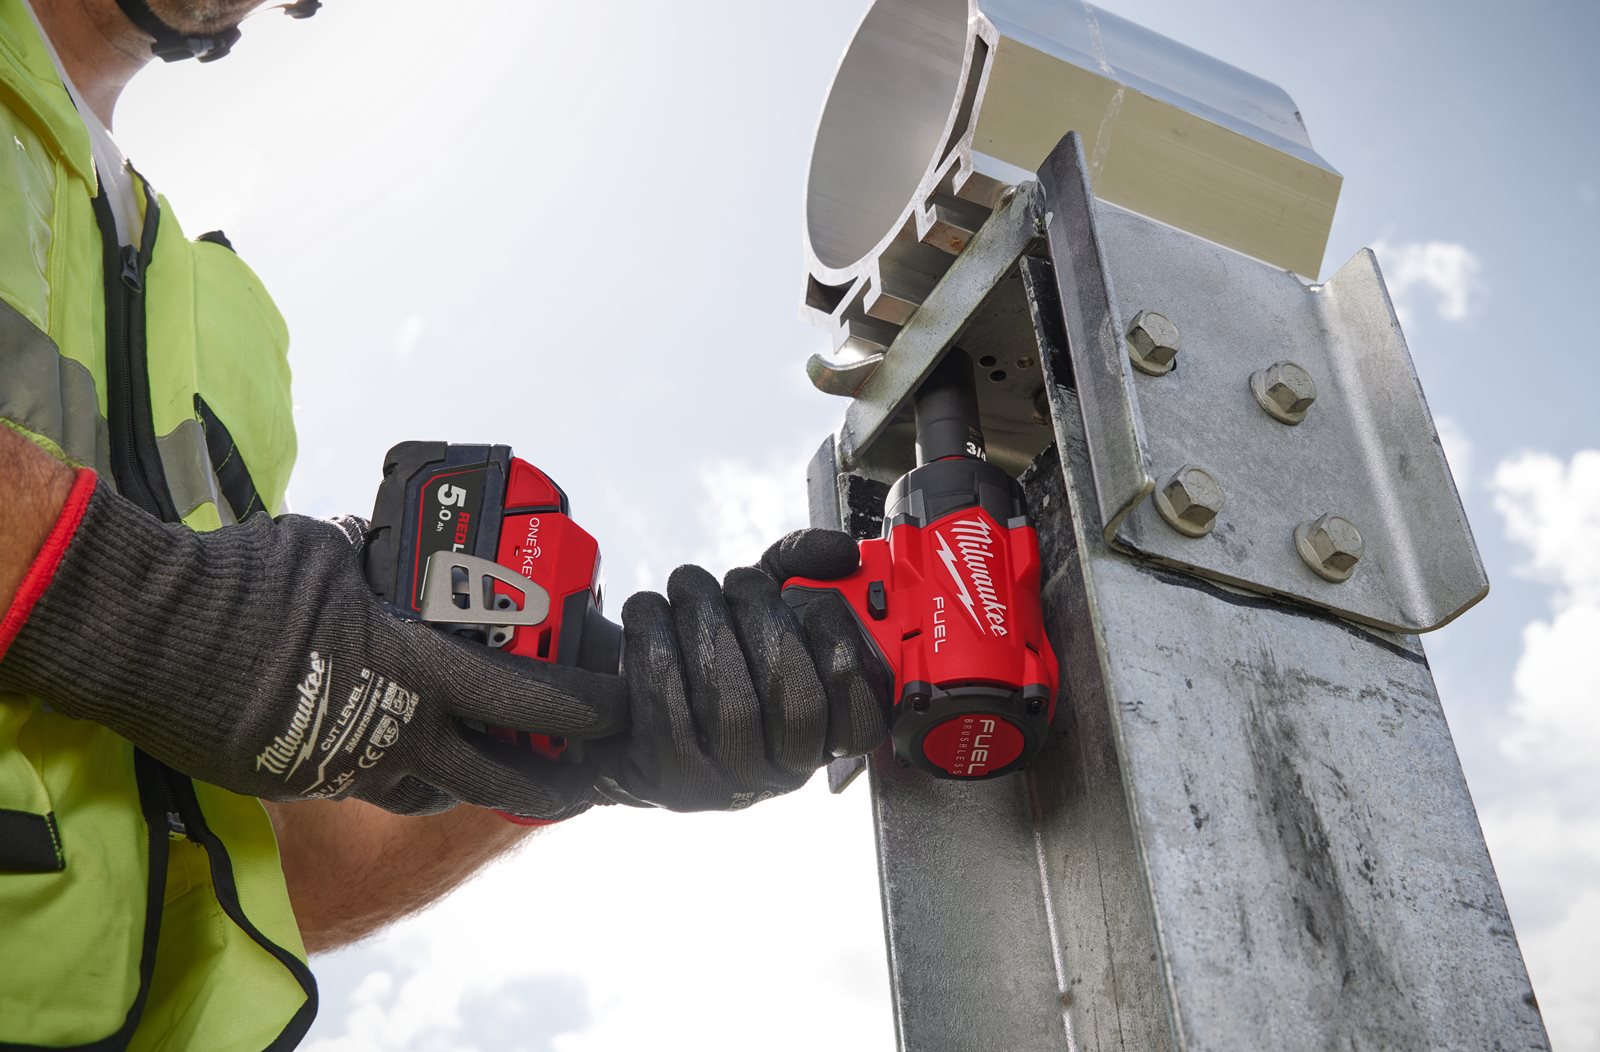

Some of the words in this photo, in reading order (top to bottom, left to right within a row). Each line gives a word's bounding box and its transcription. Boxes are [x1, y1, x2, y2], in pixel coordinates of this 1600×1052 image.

[437, 483, 467, 521] 5.0
[452, 511, 470, 552] REDL
[526, 517, 540, 547] ONE
[521, 555, 533, 579] KE
[950, 515, 1008, 637] Milwaukee
[932, 596, 947, 653] FUEL
[380, 681, 397, 709] EN388
[321, 724, 339, 751] CUT
[337, 683, 365, 726] LEVEL
[383, 726, 397, 744] A5
[953, 718, 973, 775] BRUSHLESS
[967, 719, 995, 775] FUEL
[332, 770, 355, 785] XL
